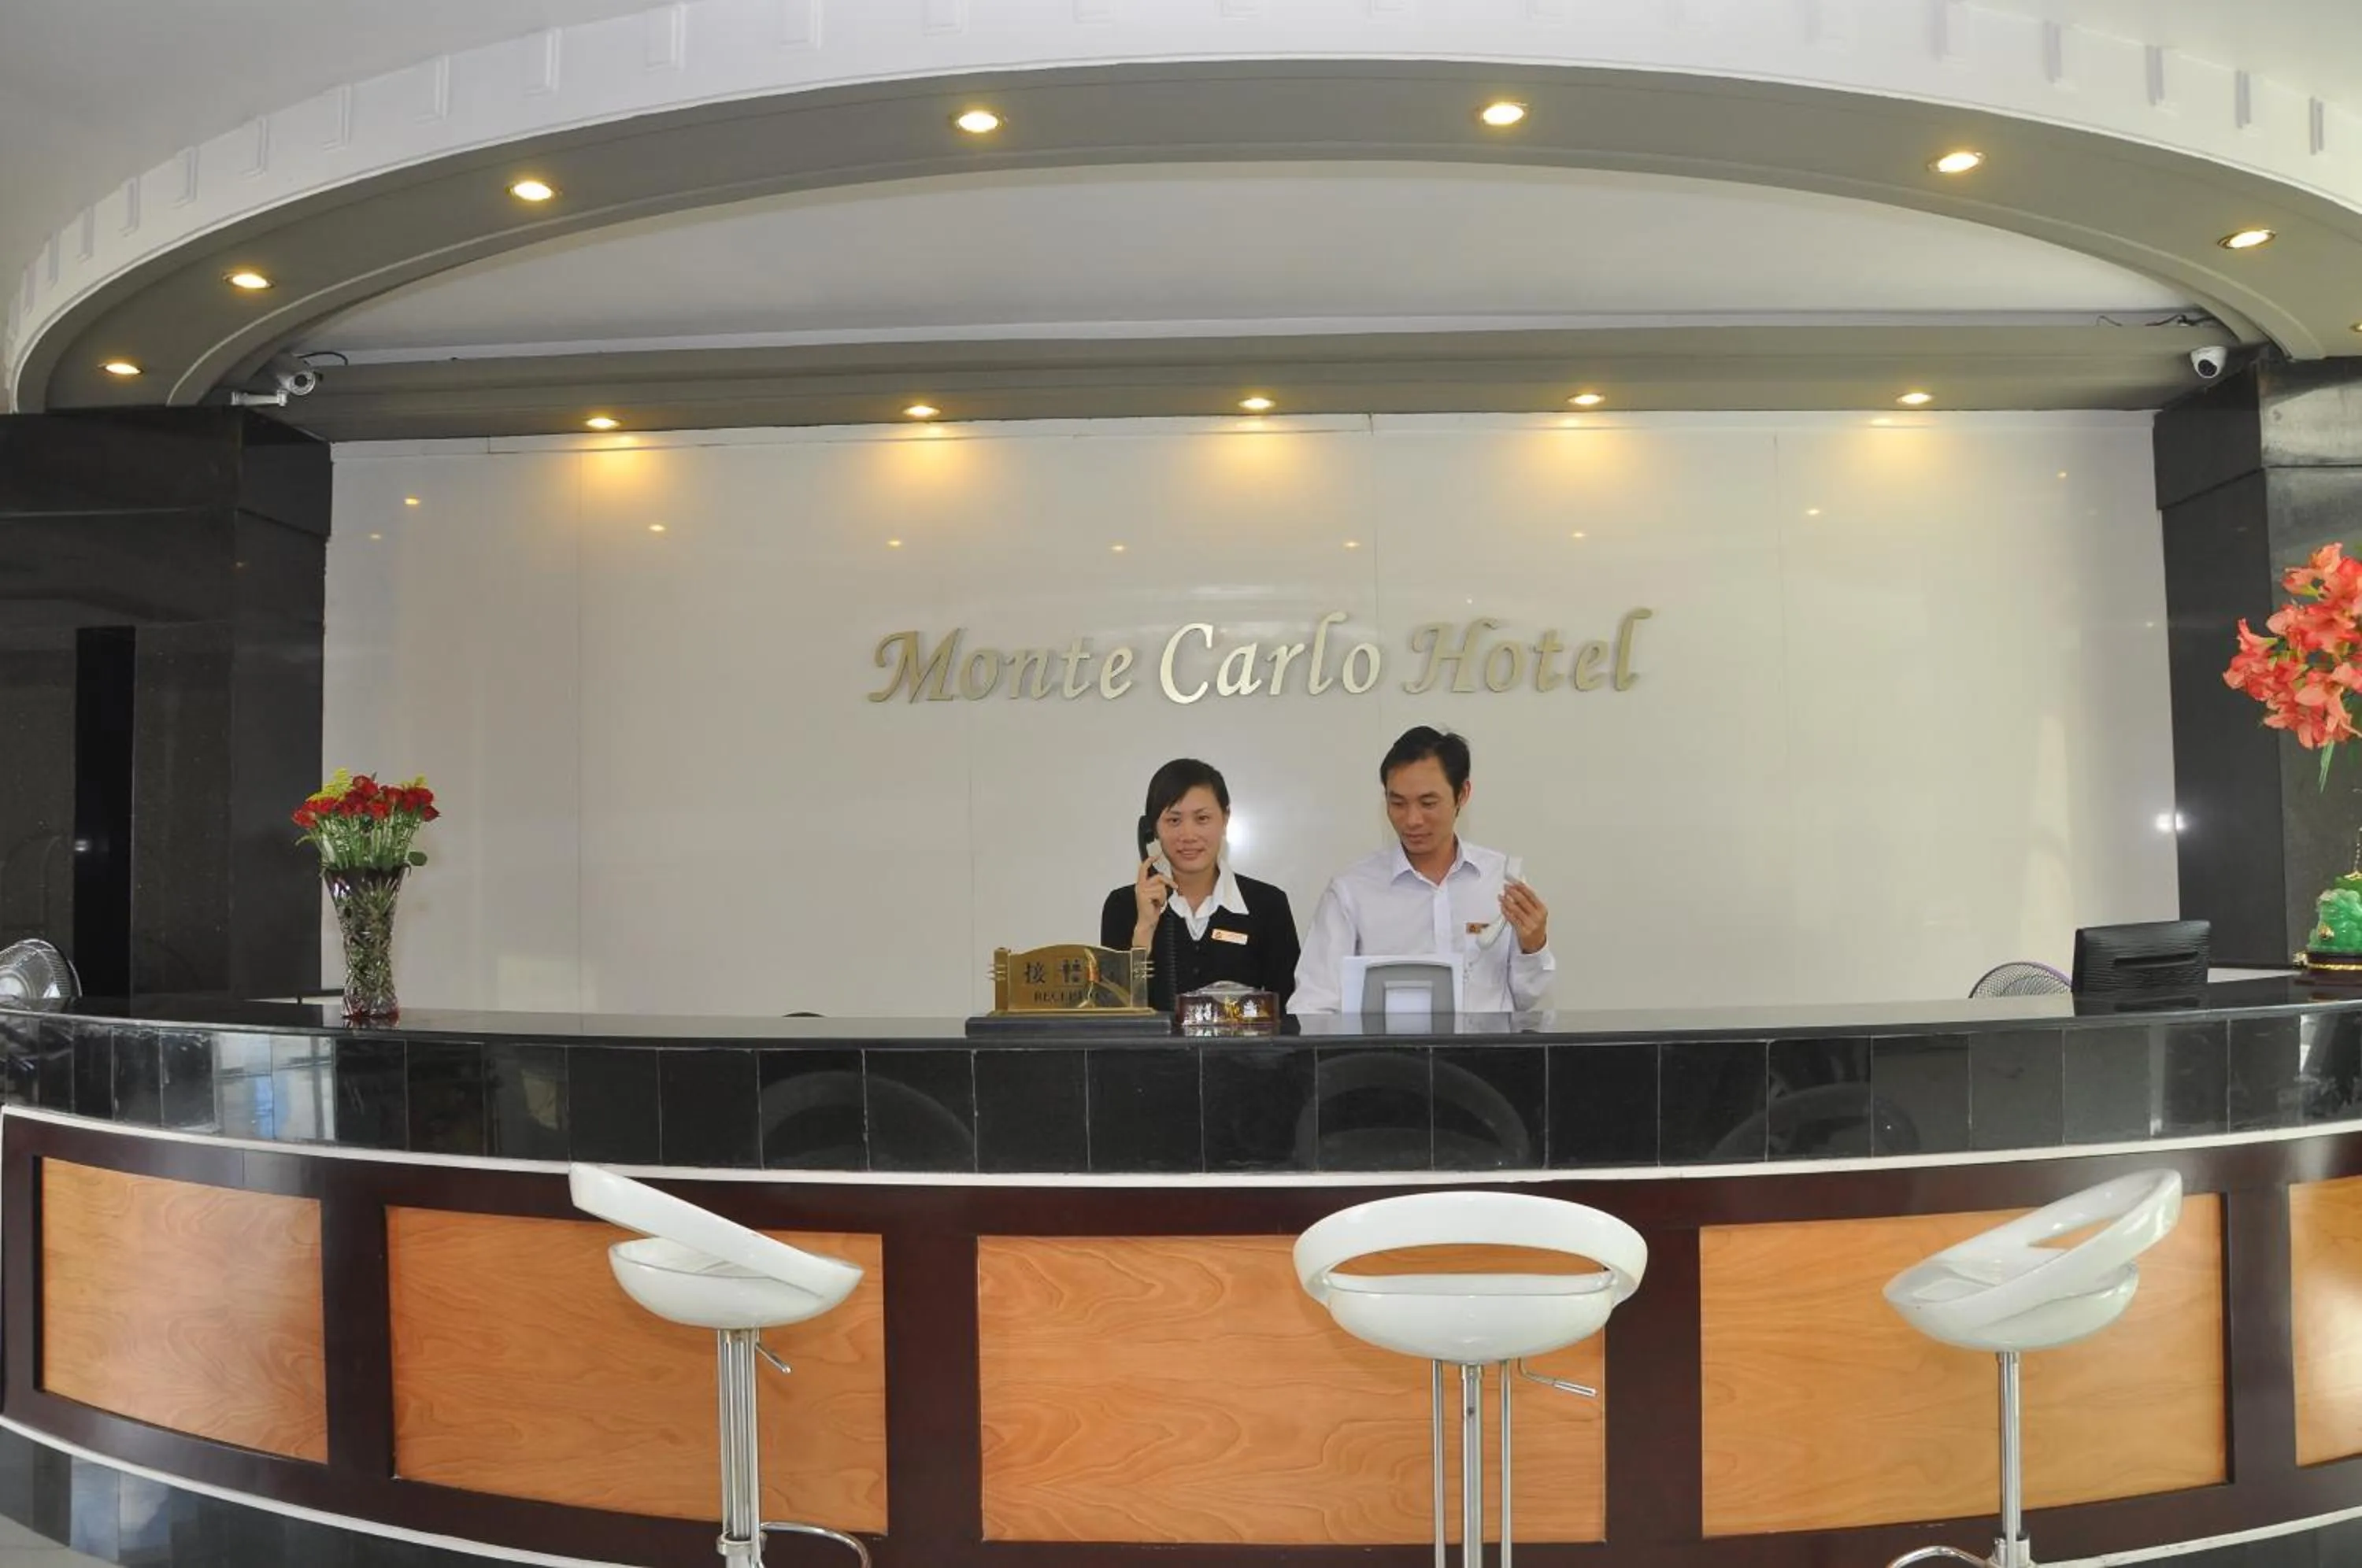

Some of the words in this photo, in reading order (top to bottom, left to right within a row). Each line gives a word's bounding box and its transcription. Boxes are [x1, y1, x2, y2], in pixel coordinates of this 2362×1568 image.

[868, 629, 1135, 702] Monte
[1159, 612, 1383, 705] Carlo
[1403, 608, 1653, 693] Hotel
[1034, 990, 1111, 1002] RECEPT
